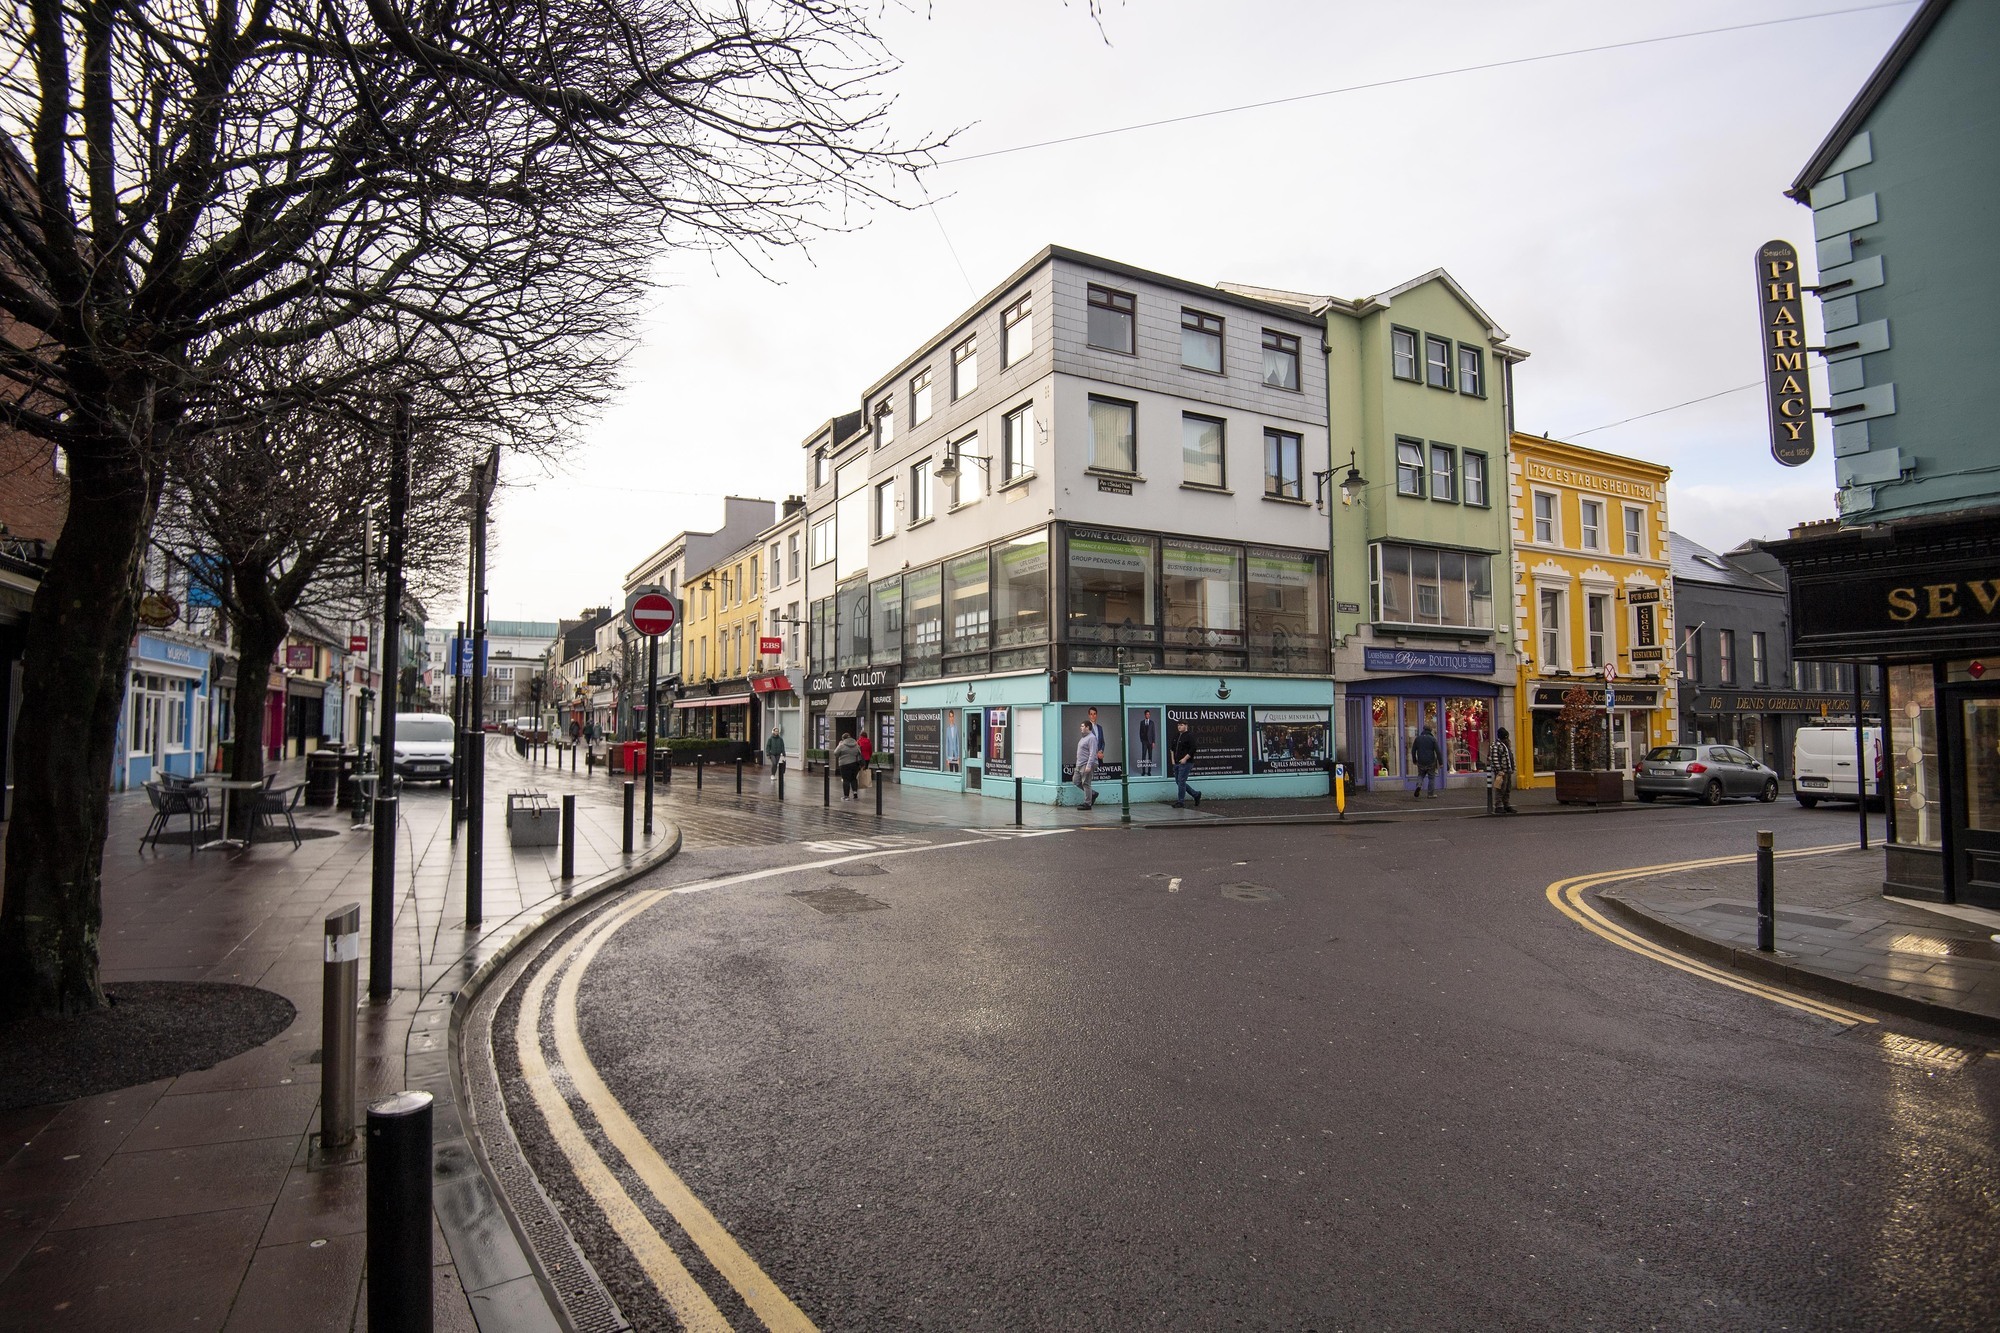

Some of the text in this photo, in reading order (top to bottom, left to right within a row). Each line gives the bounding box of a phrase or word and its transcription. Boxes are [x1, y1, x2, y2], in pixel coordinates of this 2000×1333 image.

[1767, 260, 1806, 441] PHARMACY
[1529, 463, 1651, 498] 1796 ESTABLISHED 1796
[1074, 530, 1102, 539] COYNE
[1112, 532, 1147, 543] CULLOTY
[1168, 540, 1192, 548] COYNE
[1200, 543, 1232, 552] CULLOTY
[1093, 557, 1120, 565] PENSIONS
[1193, 566, 1222, 574] INSURANCE
[1395, 651, 1468, 669] Bijou BOUTIQUE
[1633, 650, 1661, 659] RESTAURANT
[813, 671, 886, 690] COYNE & CULLOTY
[1709, 697, 1722, 709] 105
[1736, 698, 1764, 710] DENIS
[904, 713, 917, 722] QUILLS
[1168, 710, 1246, 721] QUILLS MENSWEAR
